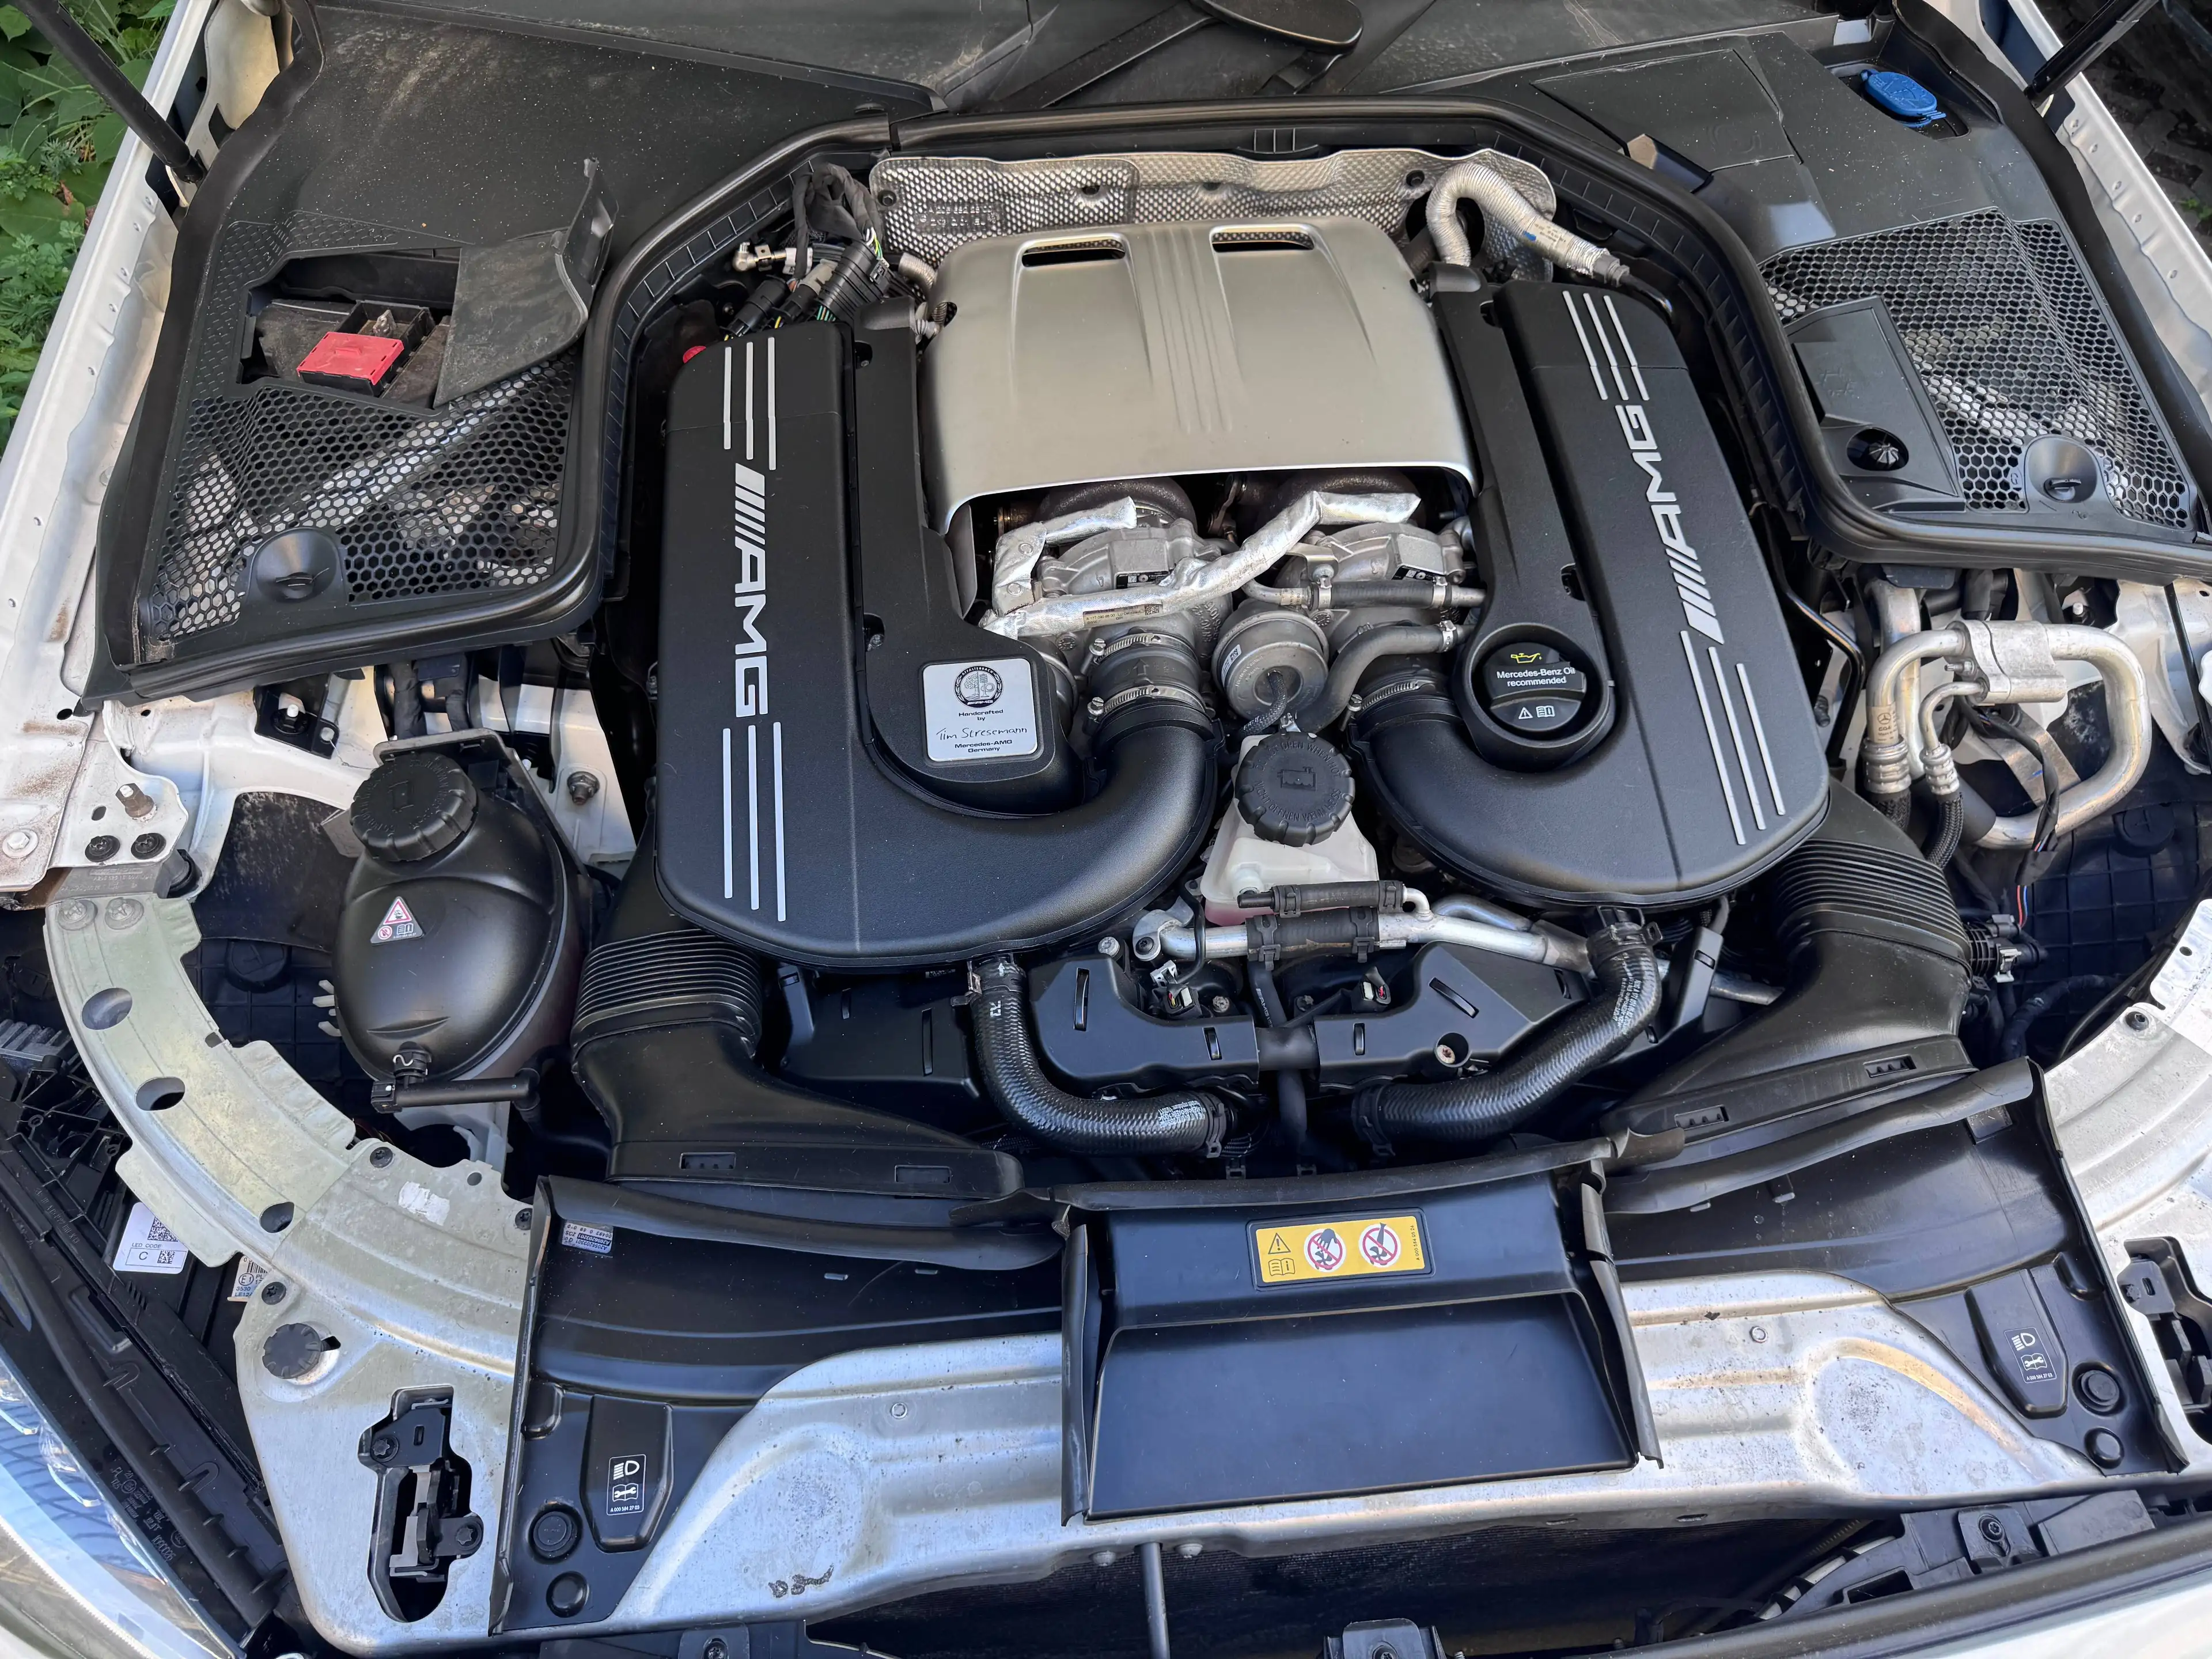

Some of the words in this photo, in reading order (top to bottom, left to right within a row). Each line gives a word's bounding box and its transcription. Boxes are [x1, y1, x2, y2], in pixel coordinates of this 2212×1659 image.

[1614, 403, 1700, 563] AMG
[734, 535, 769, 718] AMG
[961, 666, 994, 676] AFFALTERBACH
[1497, 669, 1562, 679] Mercedes-Benz
[1507, 676, 1567, 687] recommended
[936, 728, 957, 740] Tim
[955, 740, 1012, 748] Mercedes-AMG
[1281, 741, 1304, 749] OPEN
[1307, 742, 1332, 763] WHEN
[1328, 761, 1342, 778] HOT
[139, 1251, 148, 1260] C
